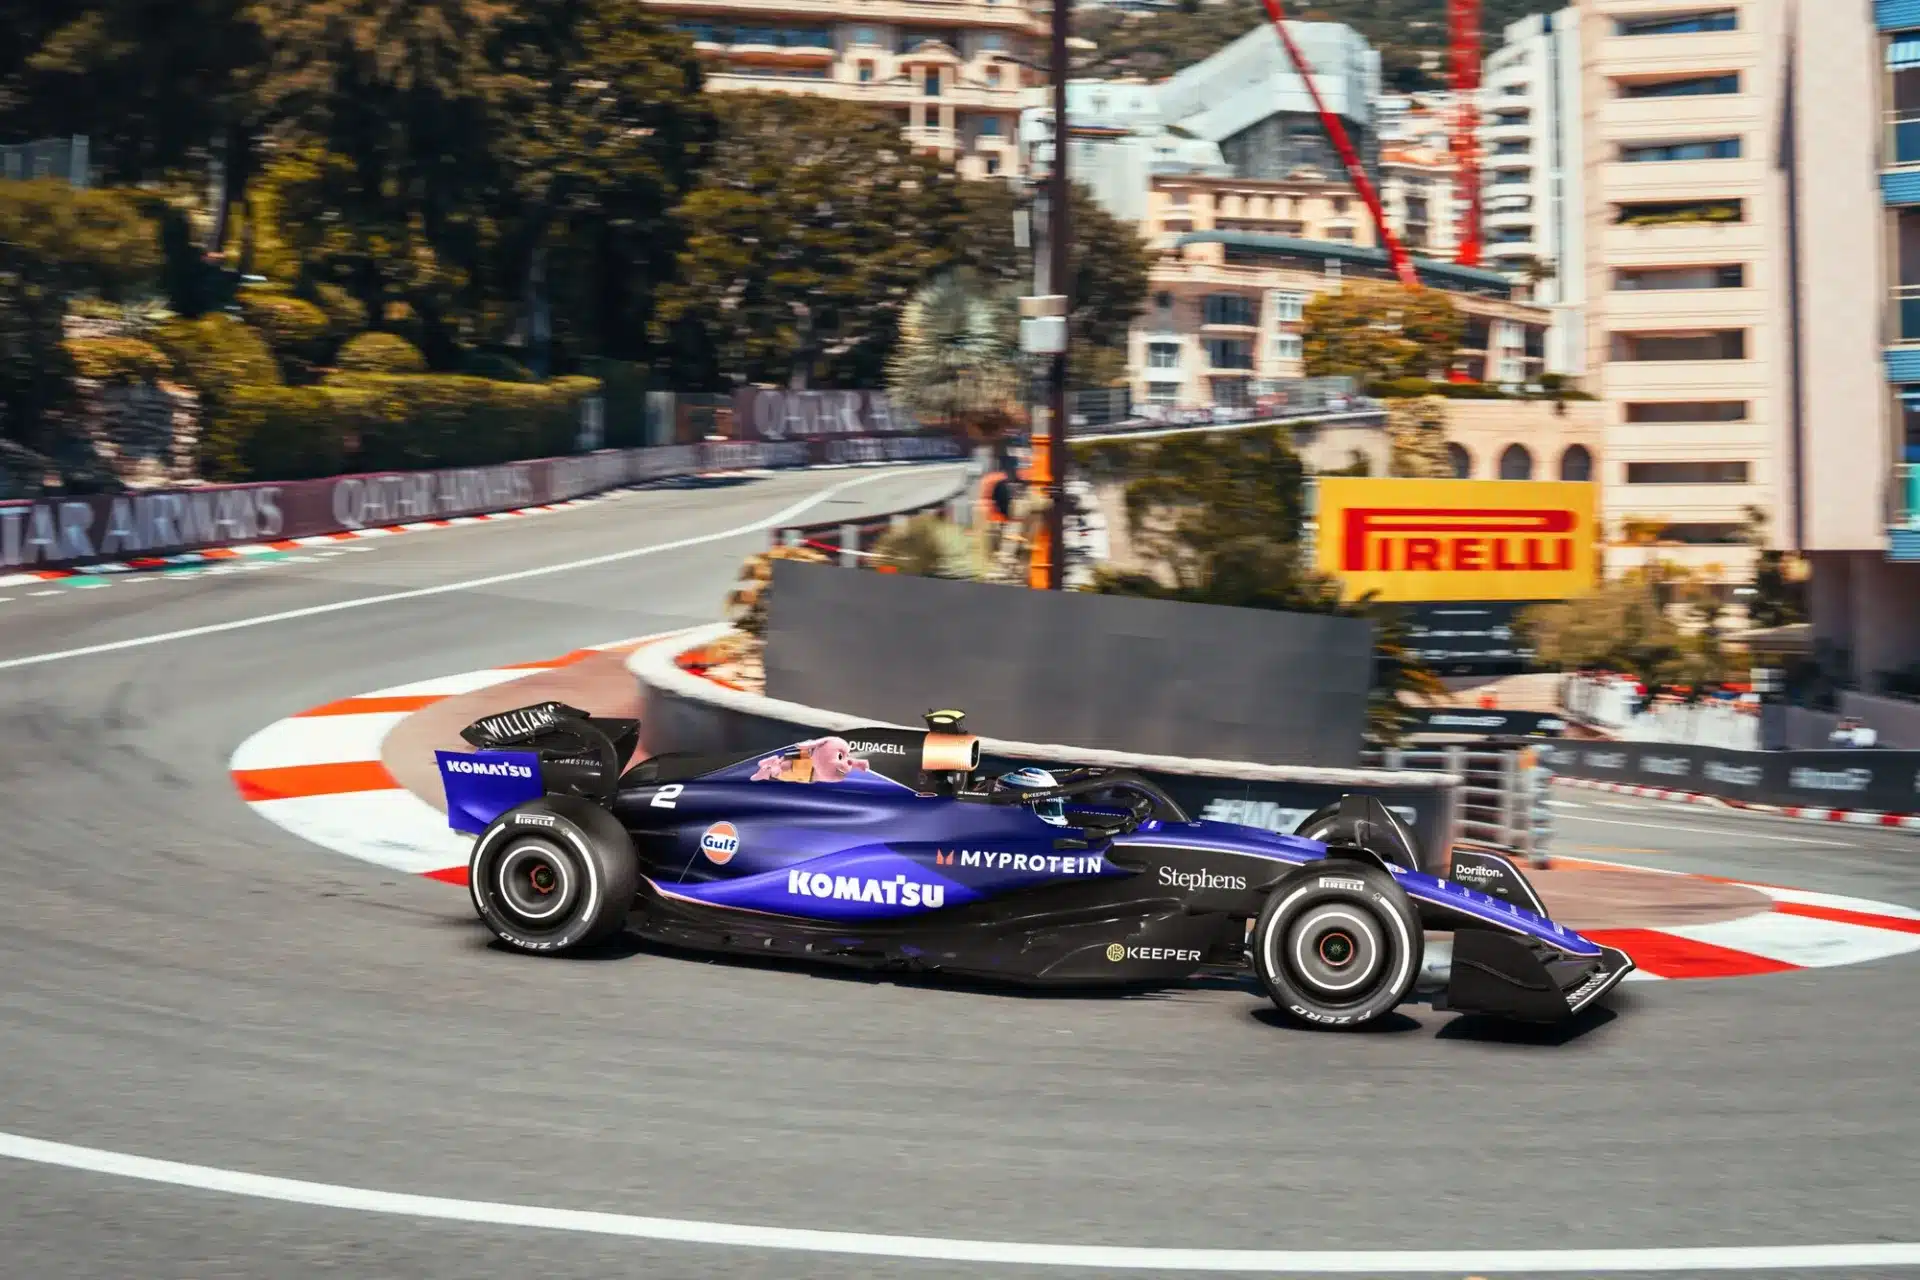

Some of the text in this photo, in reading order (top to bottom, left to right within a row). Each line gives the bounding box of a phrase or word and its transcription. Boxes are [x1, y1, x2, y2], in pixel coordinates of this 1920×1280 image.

[101, 487, 283, 553] AIRWAYS
[1340, 508, 1580, 571] PIRELLI
[848, 740, 906, 755] DURACELL
[446, 760, 532, 778] KOMATSU
[650, 784, 684, 809] 2
[515, 813, 555, 827] PIRELLI
[703, 835, 736, 851] Gulf
[960, 850, 1102, 874] MYPROTEIN
[1158, 866, 1246, 891] Stephens
[1319, 877, 1364, 891] PIRELLI
[788, 869, 944, 908] KOMATSU
[500, 931, 551, 949] ZERO
[1126, 947, 1201, 961] KEEPER
[1290, 1004, 1352, 1024] ZERO
